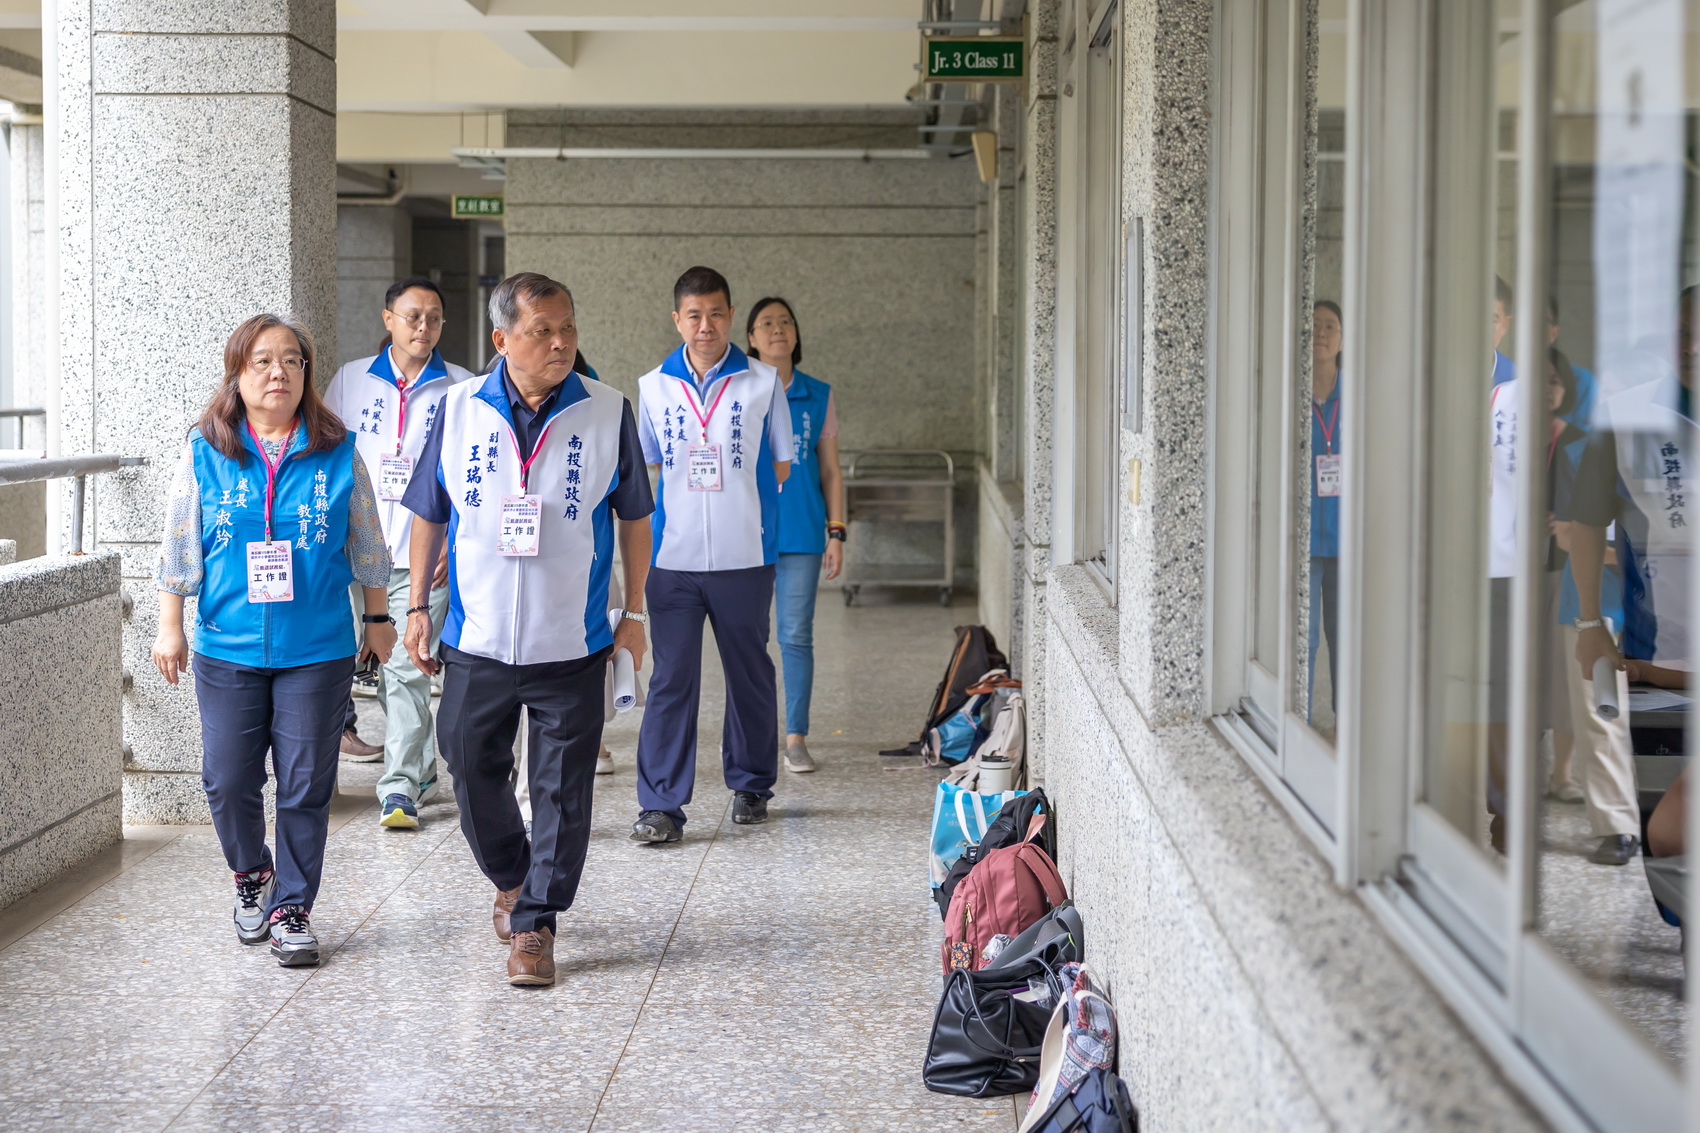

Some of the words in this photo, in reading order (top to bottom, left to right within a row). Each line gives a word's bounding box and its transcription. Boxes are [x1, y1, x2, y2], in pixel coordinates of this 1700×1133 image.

[931, 51, 949, 73] Jr.
[952, 52, 962, 69] 3
[964, 52, 999, 69] Class
[1002, 53, 1016, 69] 11
[676, 404, 688, 441] 人事處
[731, 400, 744, 469] 南投縣政府
[486, 432, 499, 473] 副縣長
[235, 477, 250, 508] 處長
[464, 445, 482, 508] 王瑞德
[563, 434, 583, 521] 南投縣政府
[215, 490, 233, 547] 王淑玲
[295, 504, 312, 550] 教育處
[313, 469, 330, 544] 南投縣政府
[503, 526, 535, 536] 工作證
[254, 572, 288, 582] 工作證
